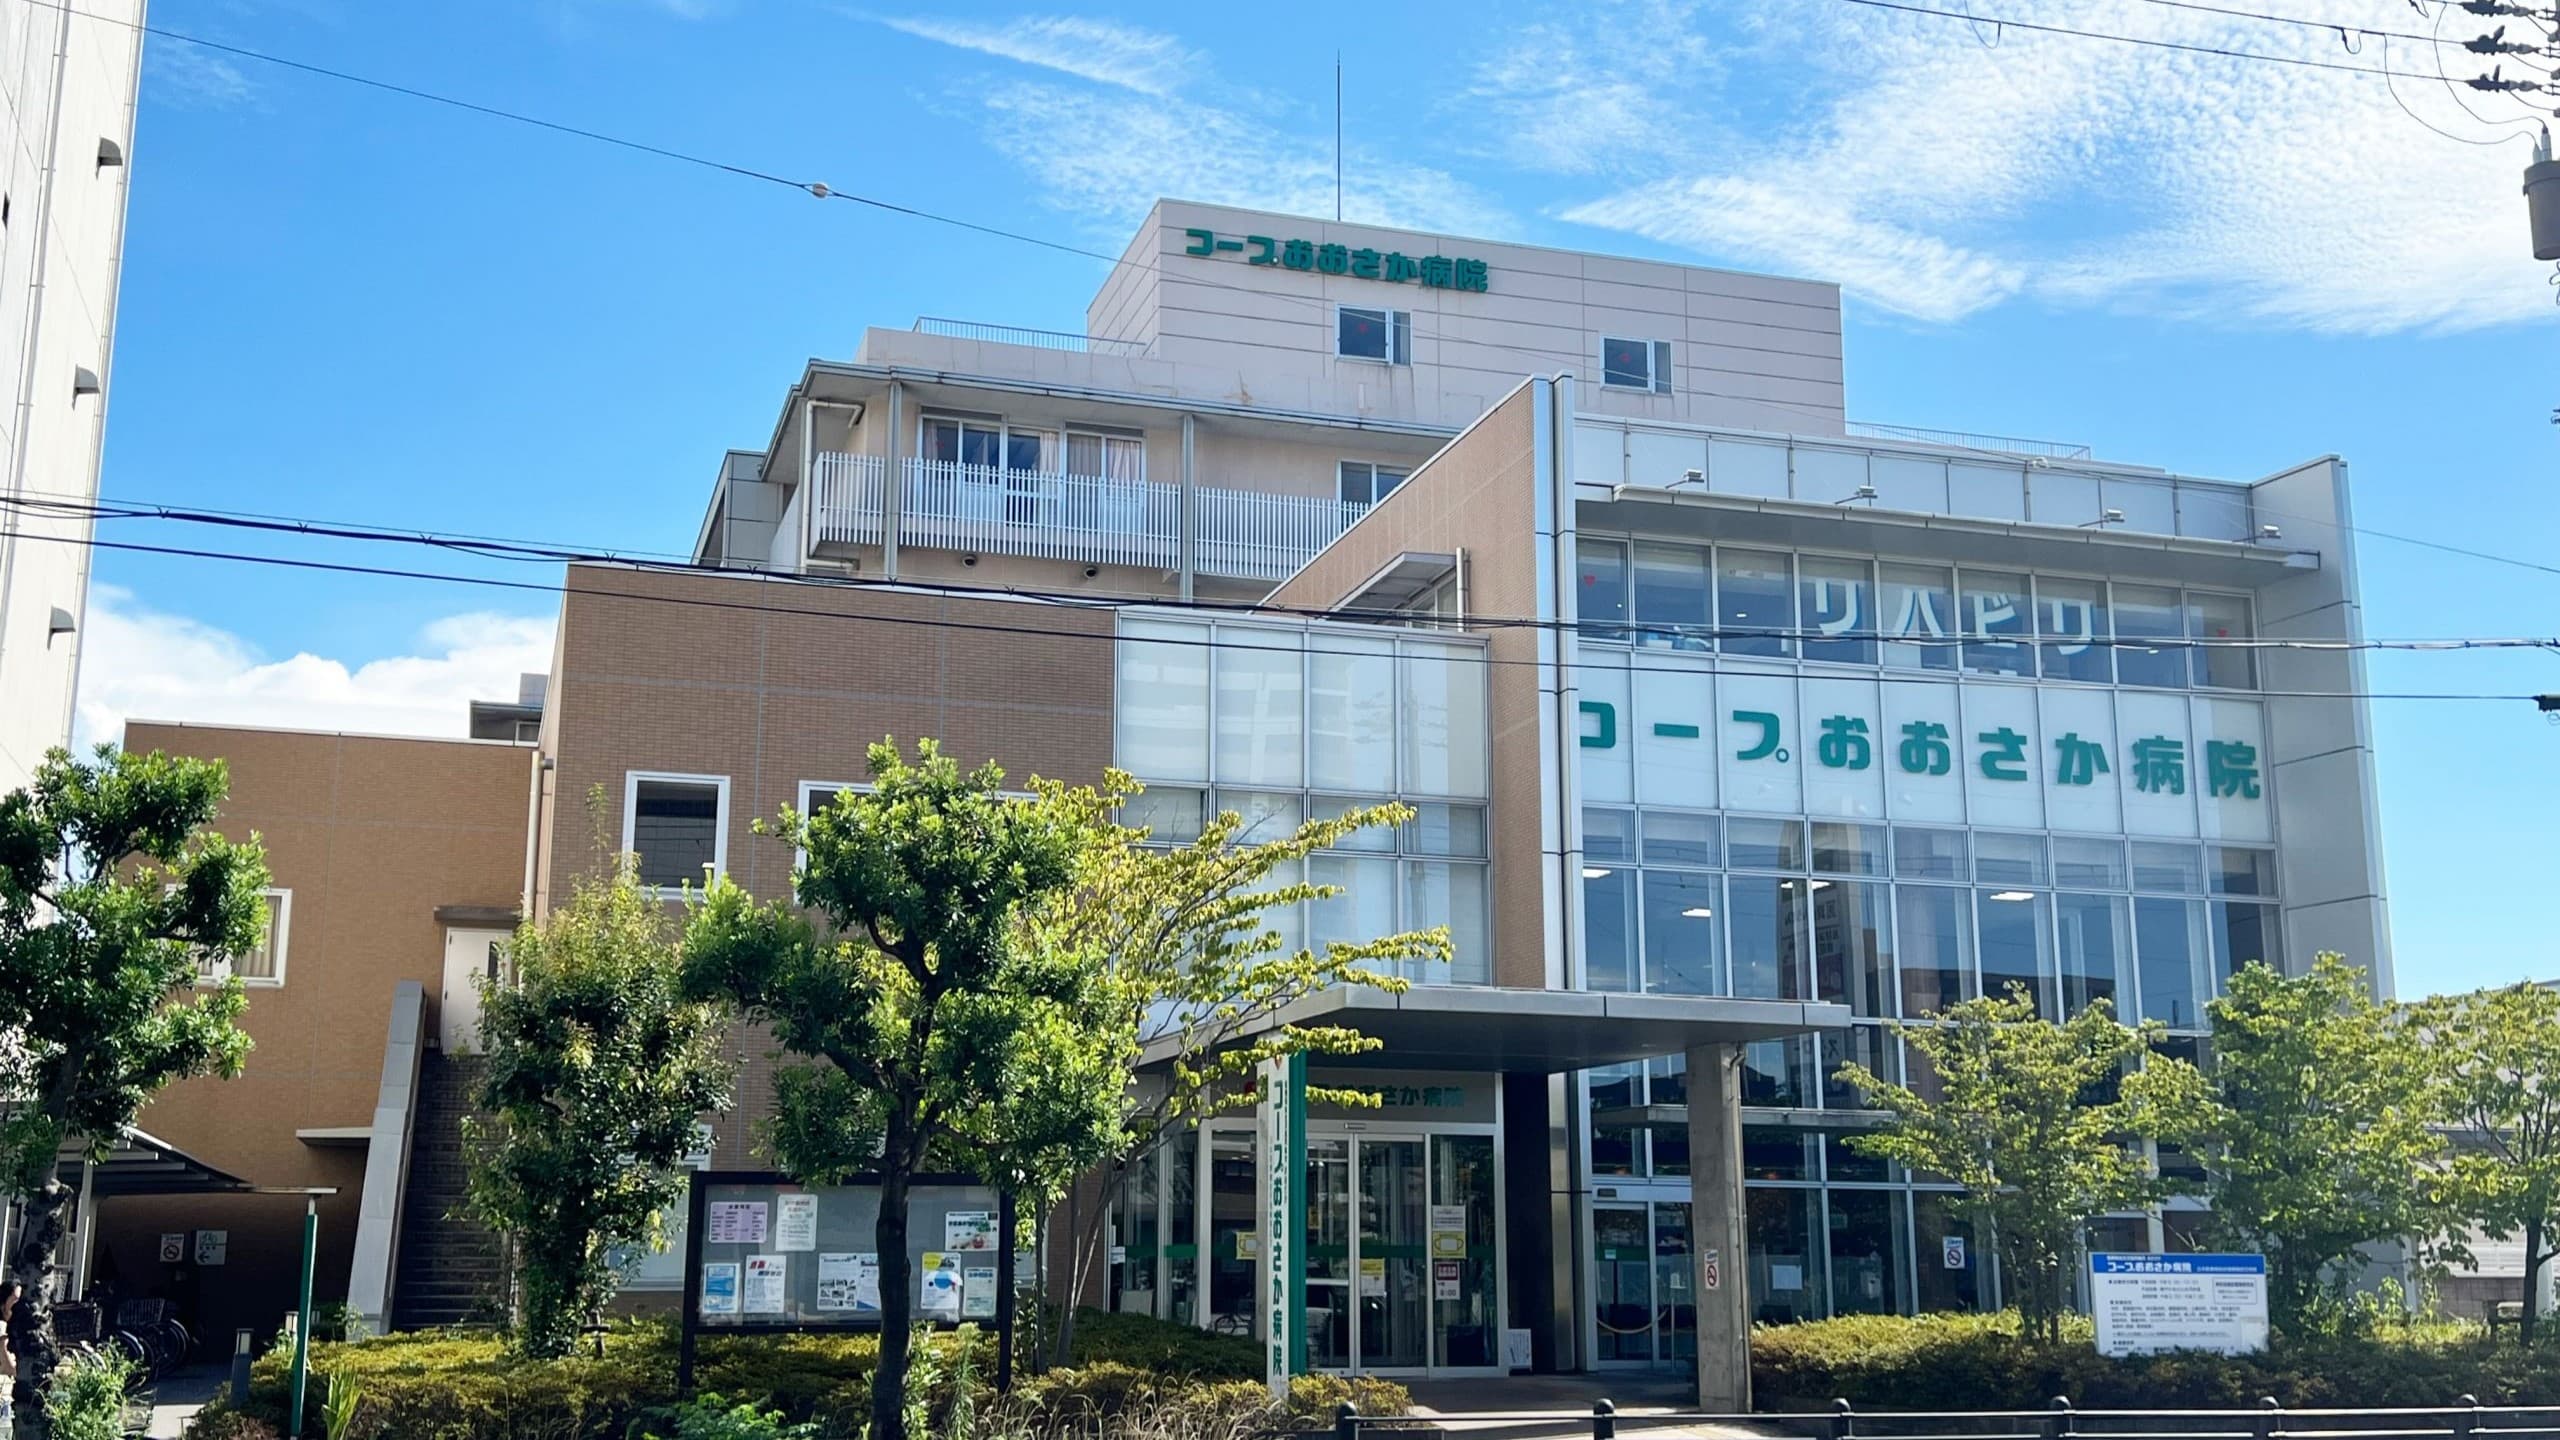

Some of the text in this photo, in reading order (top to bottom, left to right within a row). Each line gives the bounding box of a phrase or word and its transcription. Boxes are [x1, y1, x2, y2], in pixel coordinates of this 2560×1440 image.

[1186, 228, 1488, 293] コープおおさか病院
[1814, 577, 2092, 656] リハビリ
[1579, 701, 2262, 799] コープおおさか病院
[1273, 1080, 1284, 1376] コープおおさか病院
